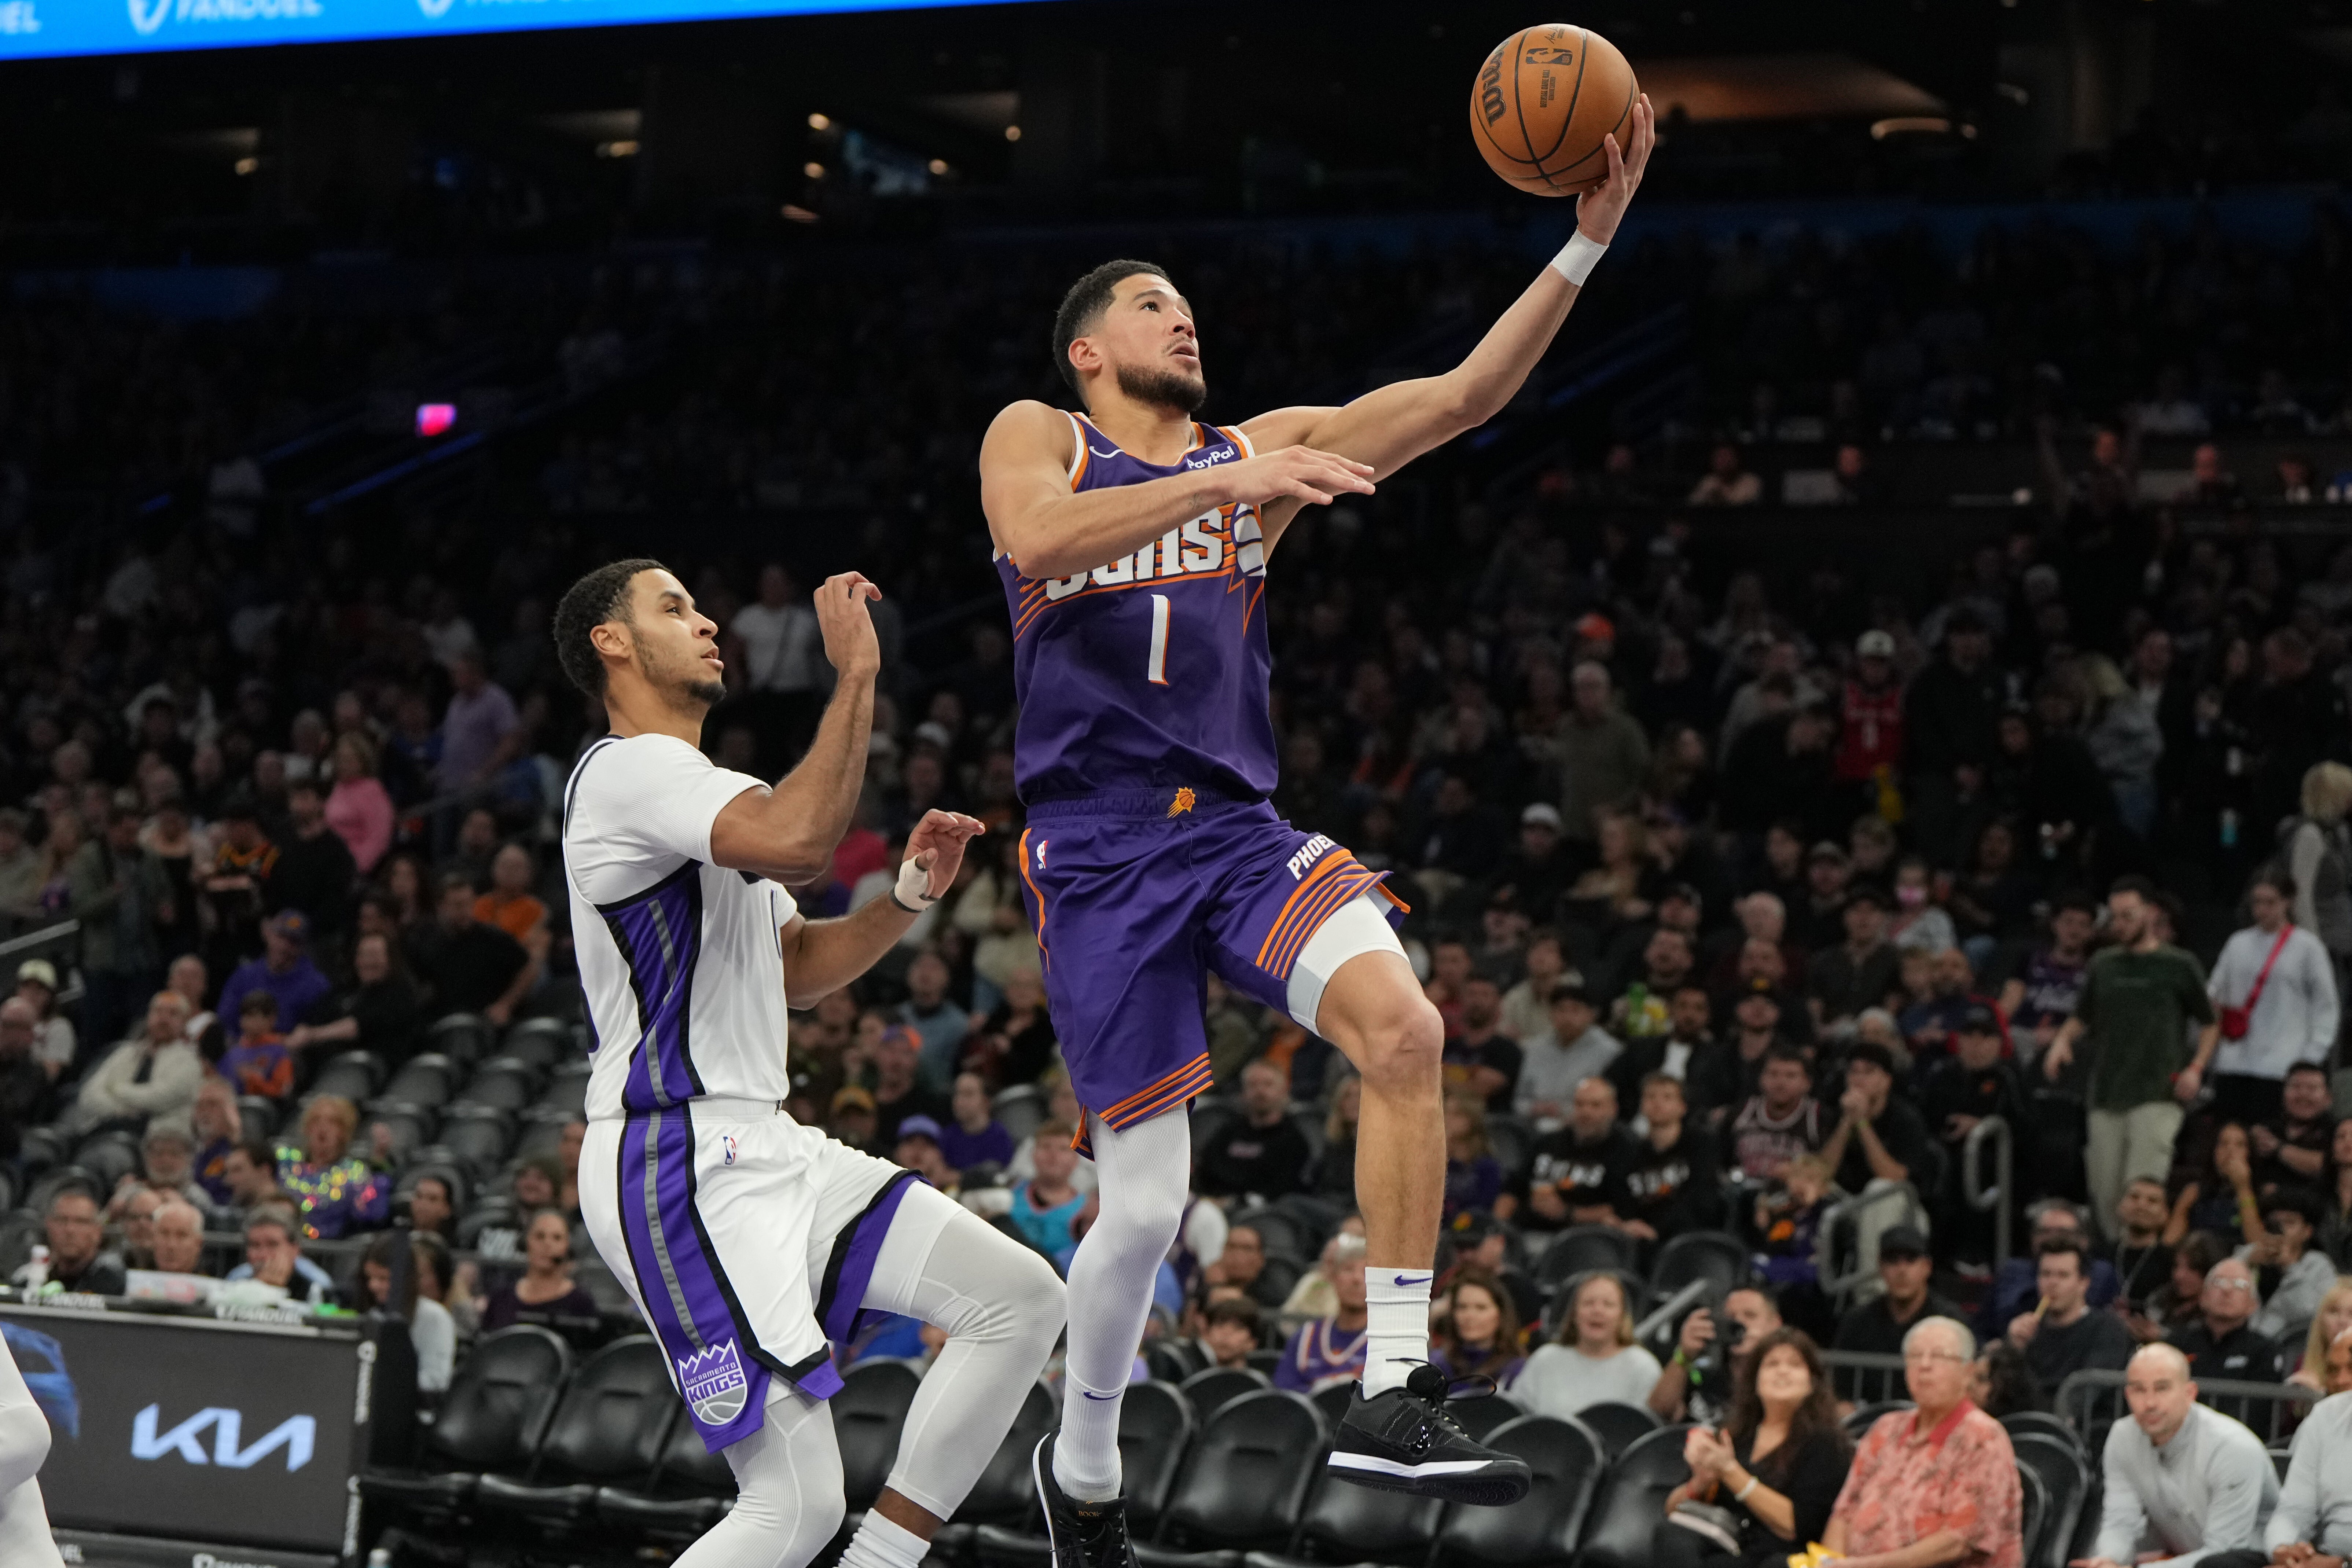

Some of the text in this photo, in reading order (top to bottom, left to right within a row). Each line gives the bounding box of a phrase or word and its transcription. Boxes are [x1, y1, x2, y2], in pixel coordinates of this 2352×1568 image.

[1187, 445, 1235, 469] PayPal
[1148, 594, 1170, 685] 1
[686, 1362, 736, 1386] SACRAMENTO
[688, 1370, 744, 1403] KINGS
